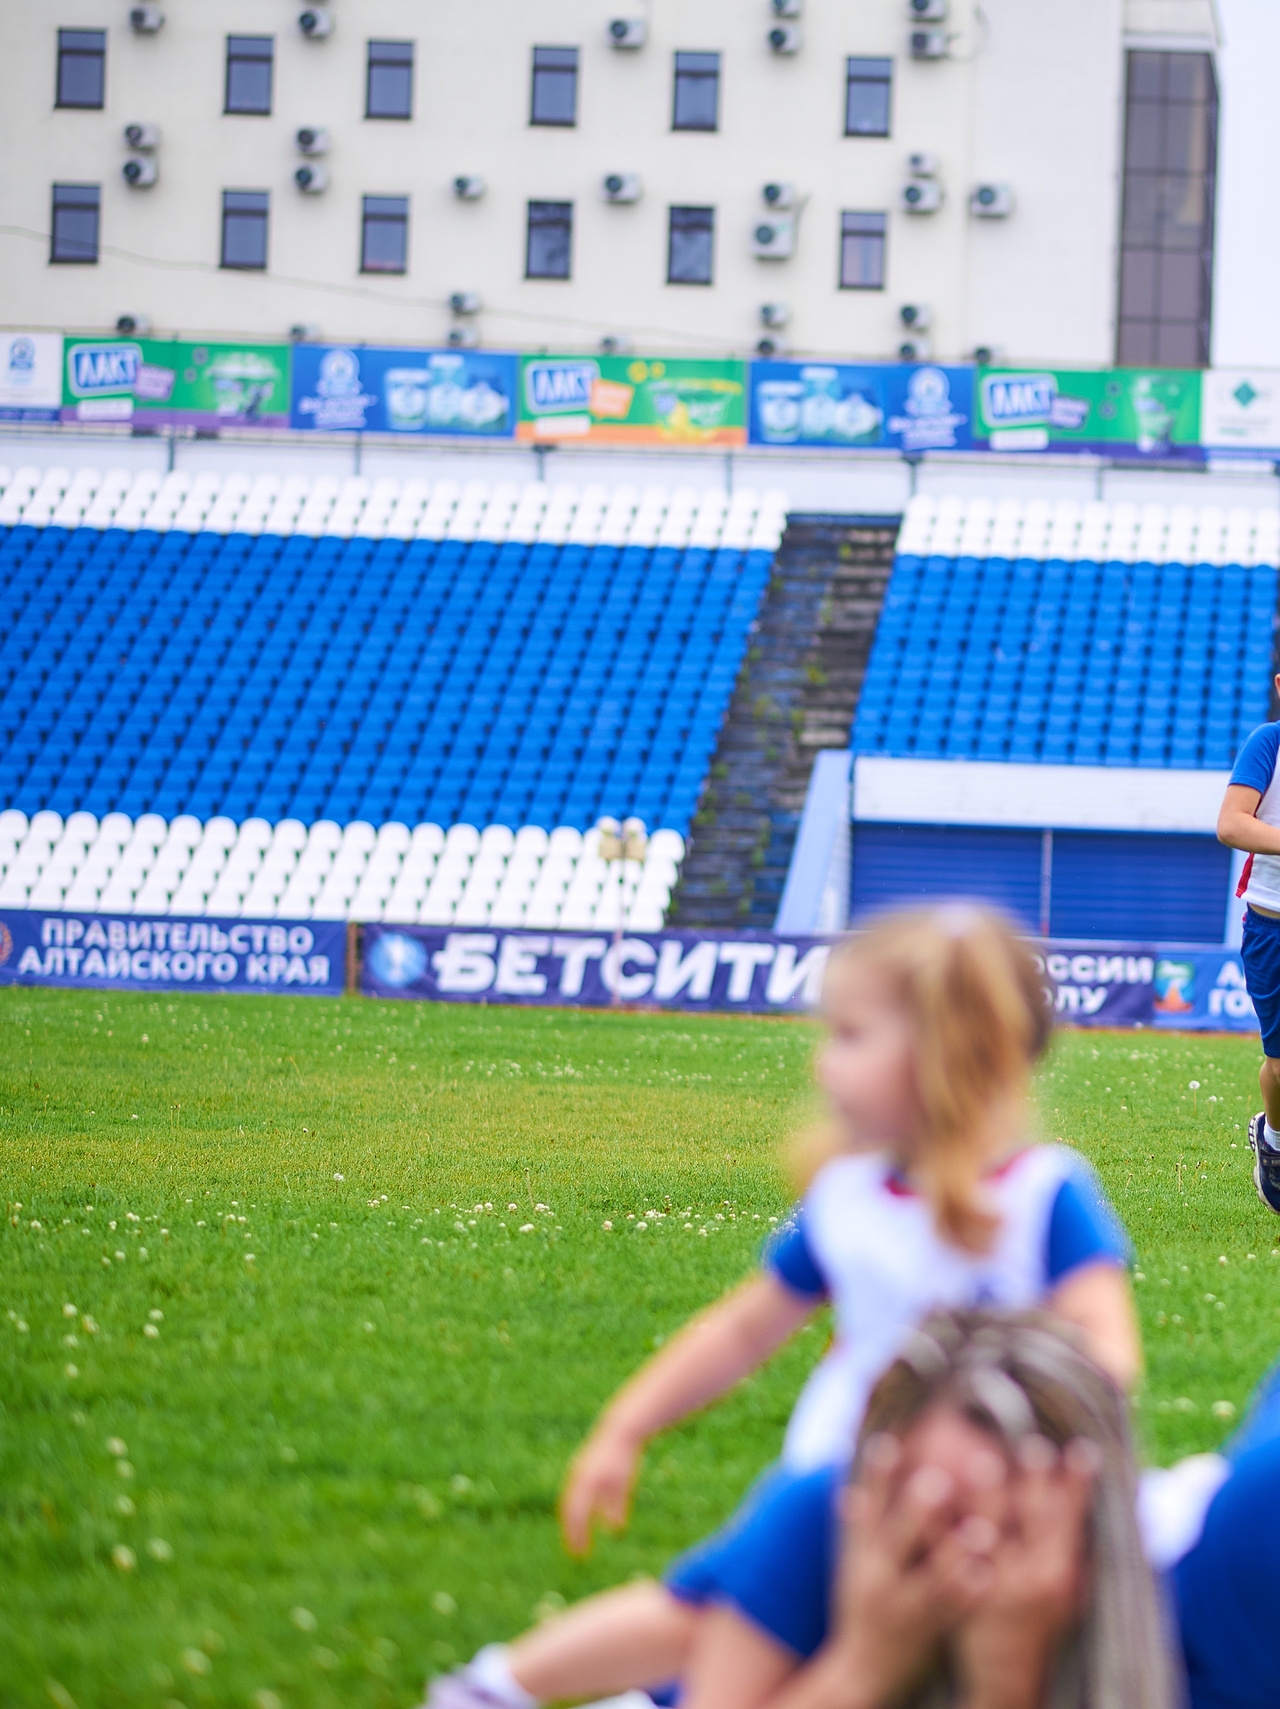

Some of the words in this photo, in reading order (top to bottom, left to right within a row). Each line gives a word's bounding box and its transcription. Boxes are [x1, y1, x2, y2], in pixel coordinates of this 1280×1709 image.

[42, 917, 315, 955] ПРАВИТЕЛЬСТВО
[18, 945, 239, 982] АЛТАЙСКОГО
[245, 951, 331, 985] КРАЯ
[432, 932, 831, 1003] БЕТСИТИ
